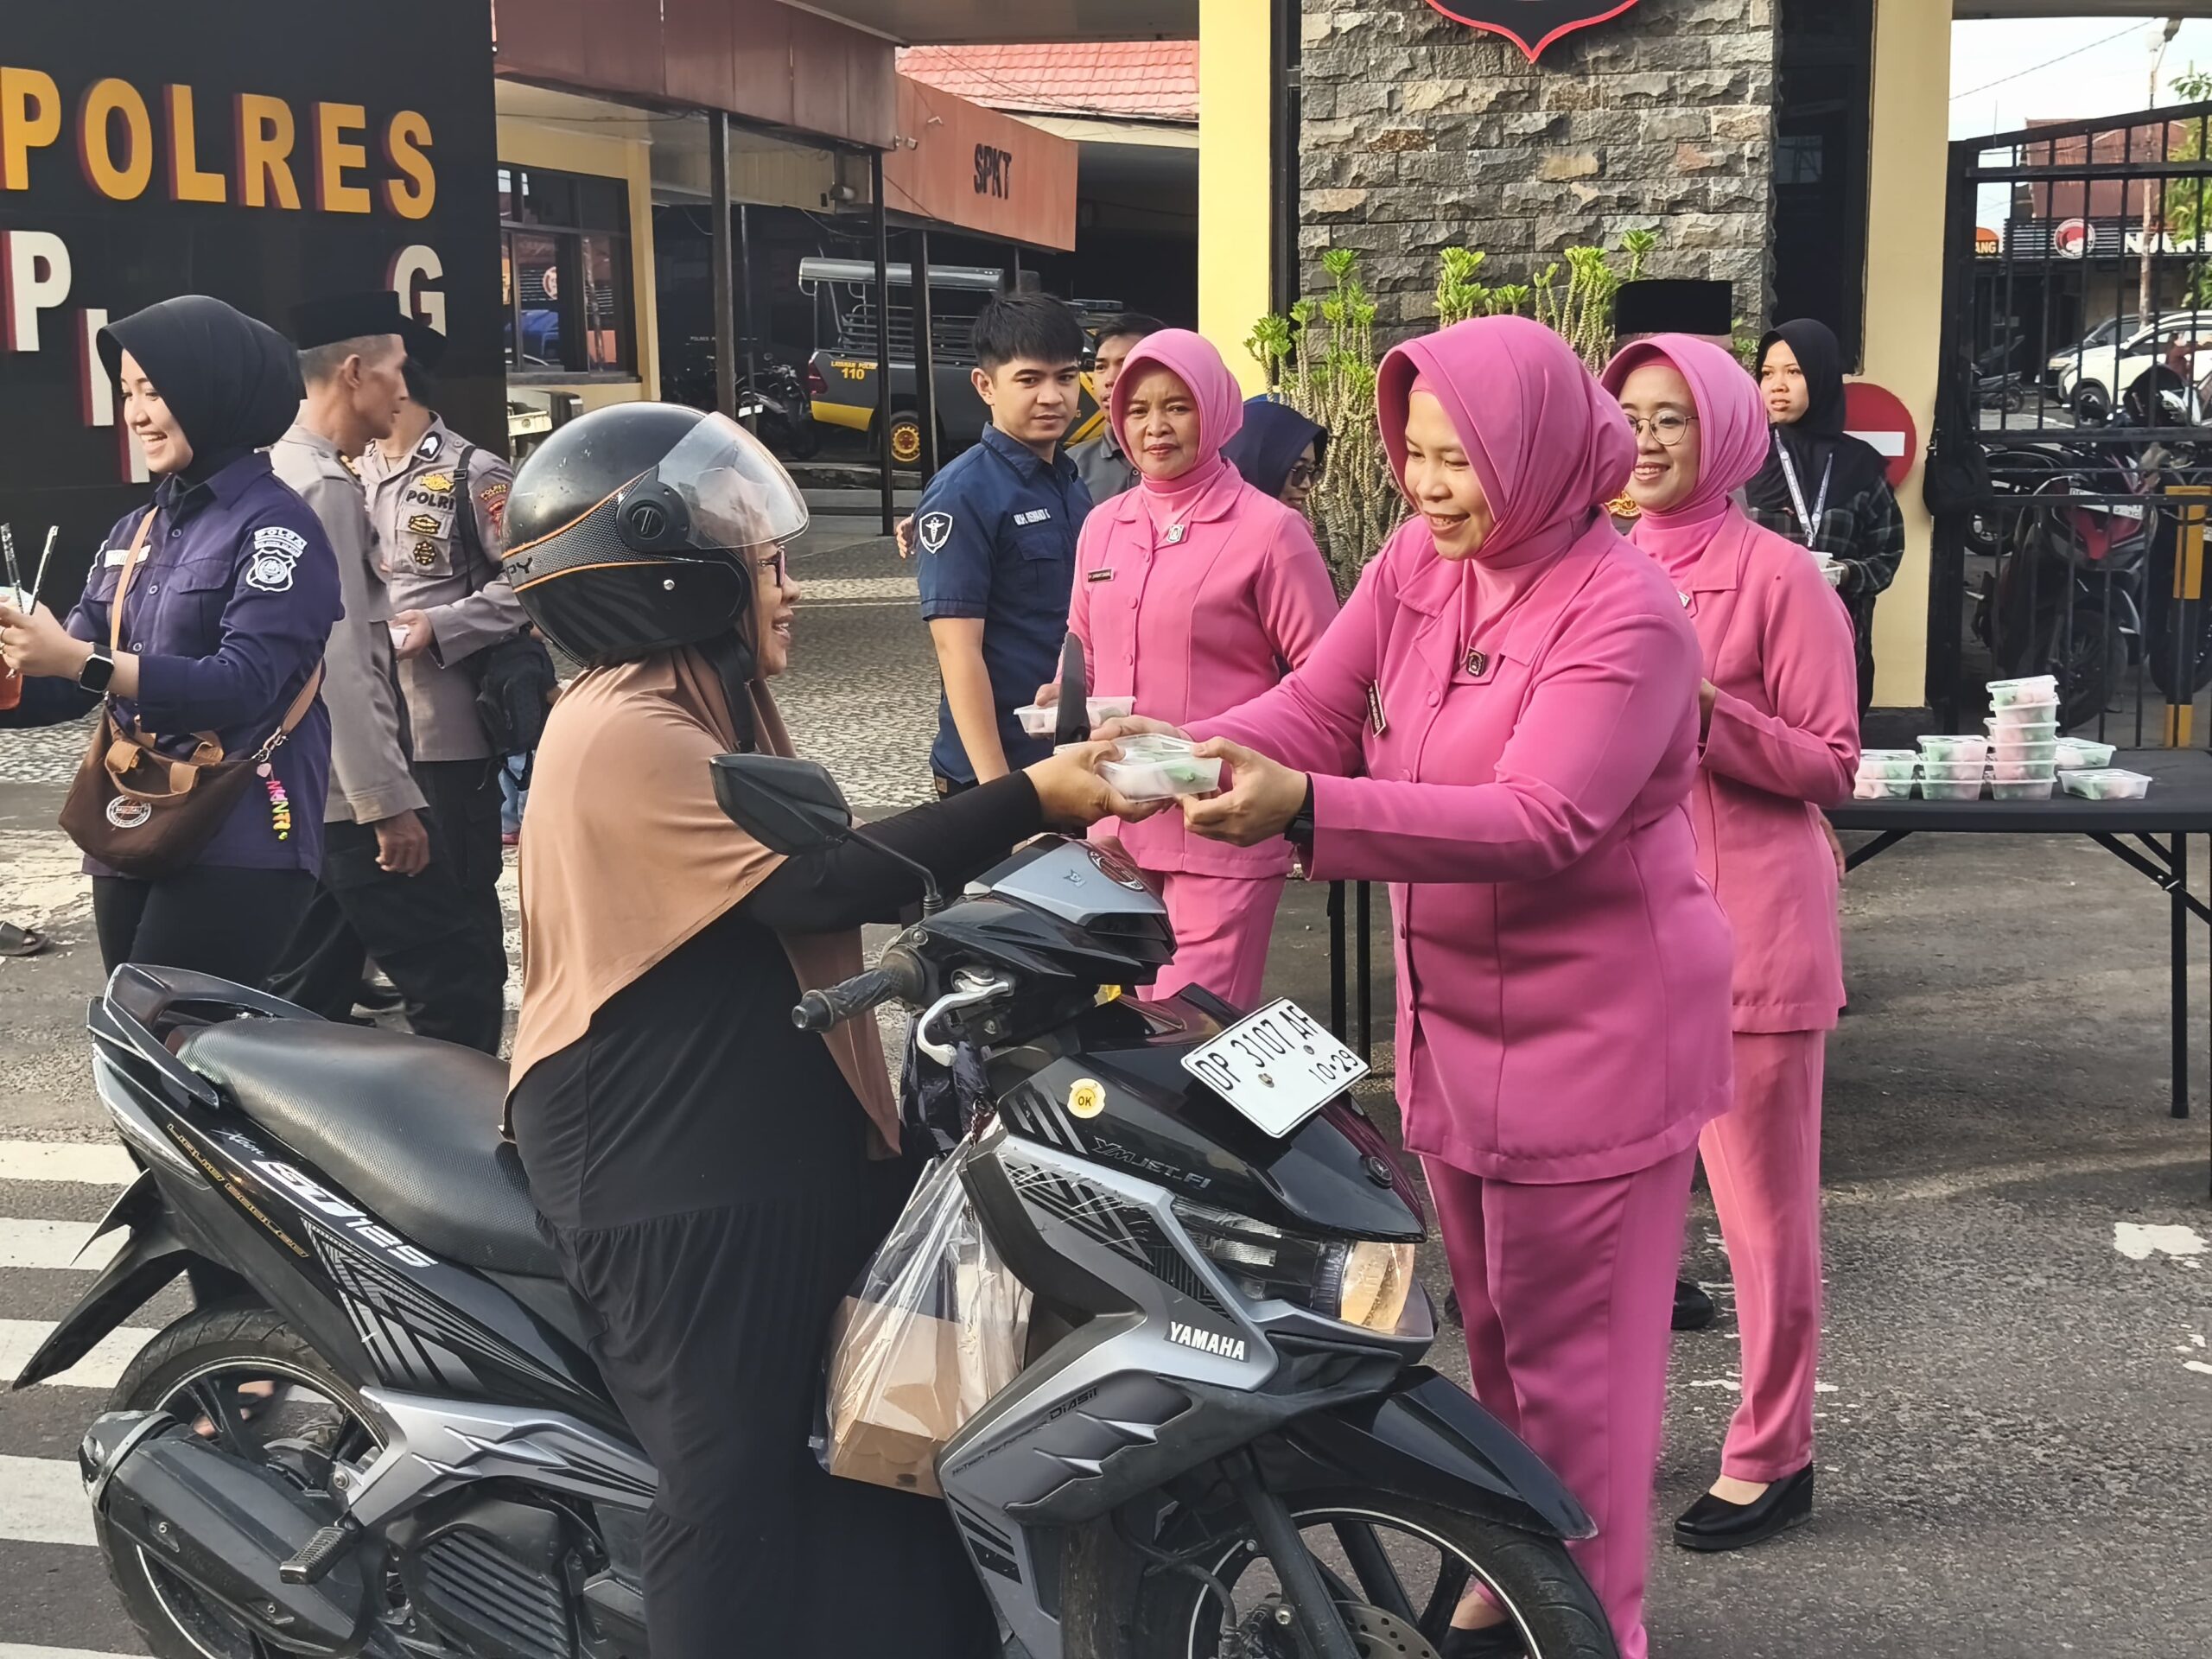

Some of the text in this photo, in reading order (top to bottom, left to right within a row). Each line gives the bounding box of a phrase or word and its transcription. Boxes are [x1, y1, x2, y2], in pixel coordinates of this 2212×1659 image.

[0, 66, 436, 220] POLRES
[973, 143, 1012, 200] SPKT
[842, 367, 865, 380] 110
[405, 489, 455, 511] POLRI
[1194, 1005, 1319, 1091] DP 3107 AF
[1077, 1095, 1092, 1108] OK
[1170, 1320, 1245, 1361] YAMAHA
